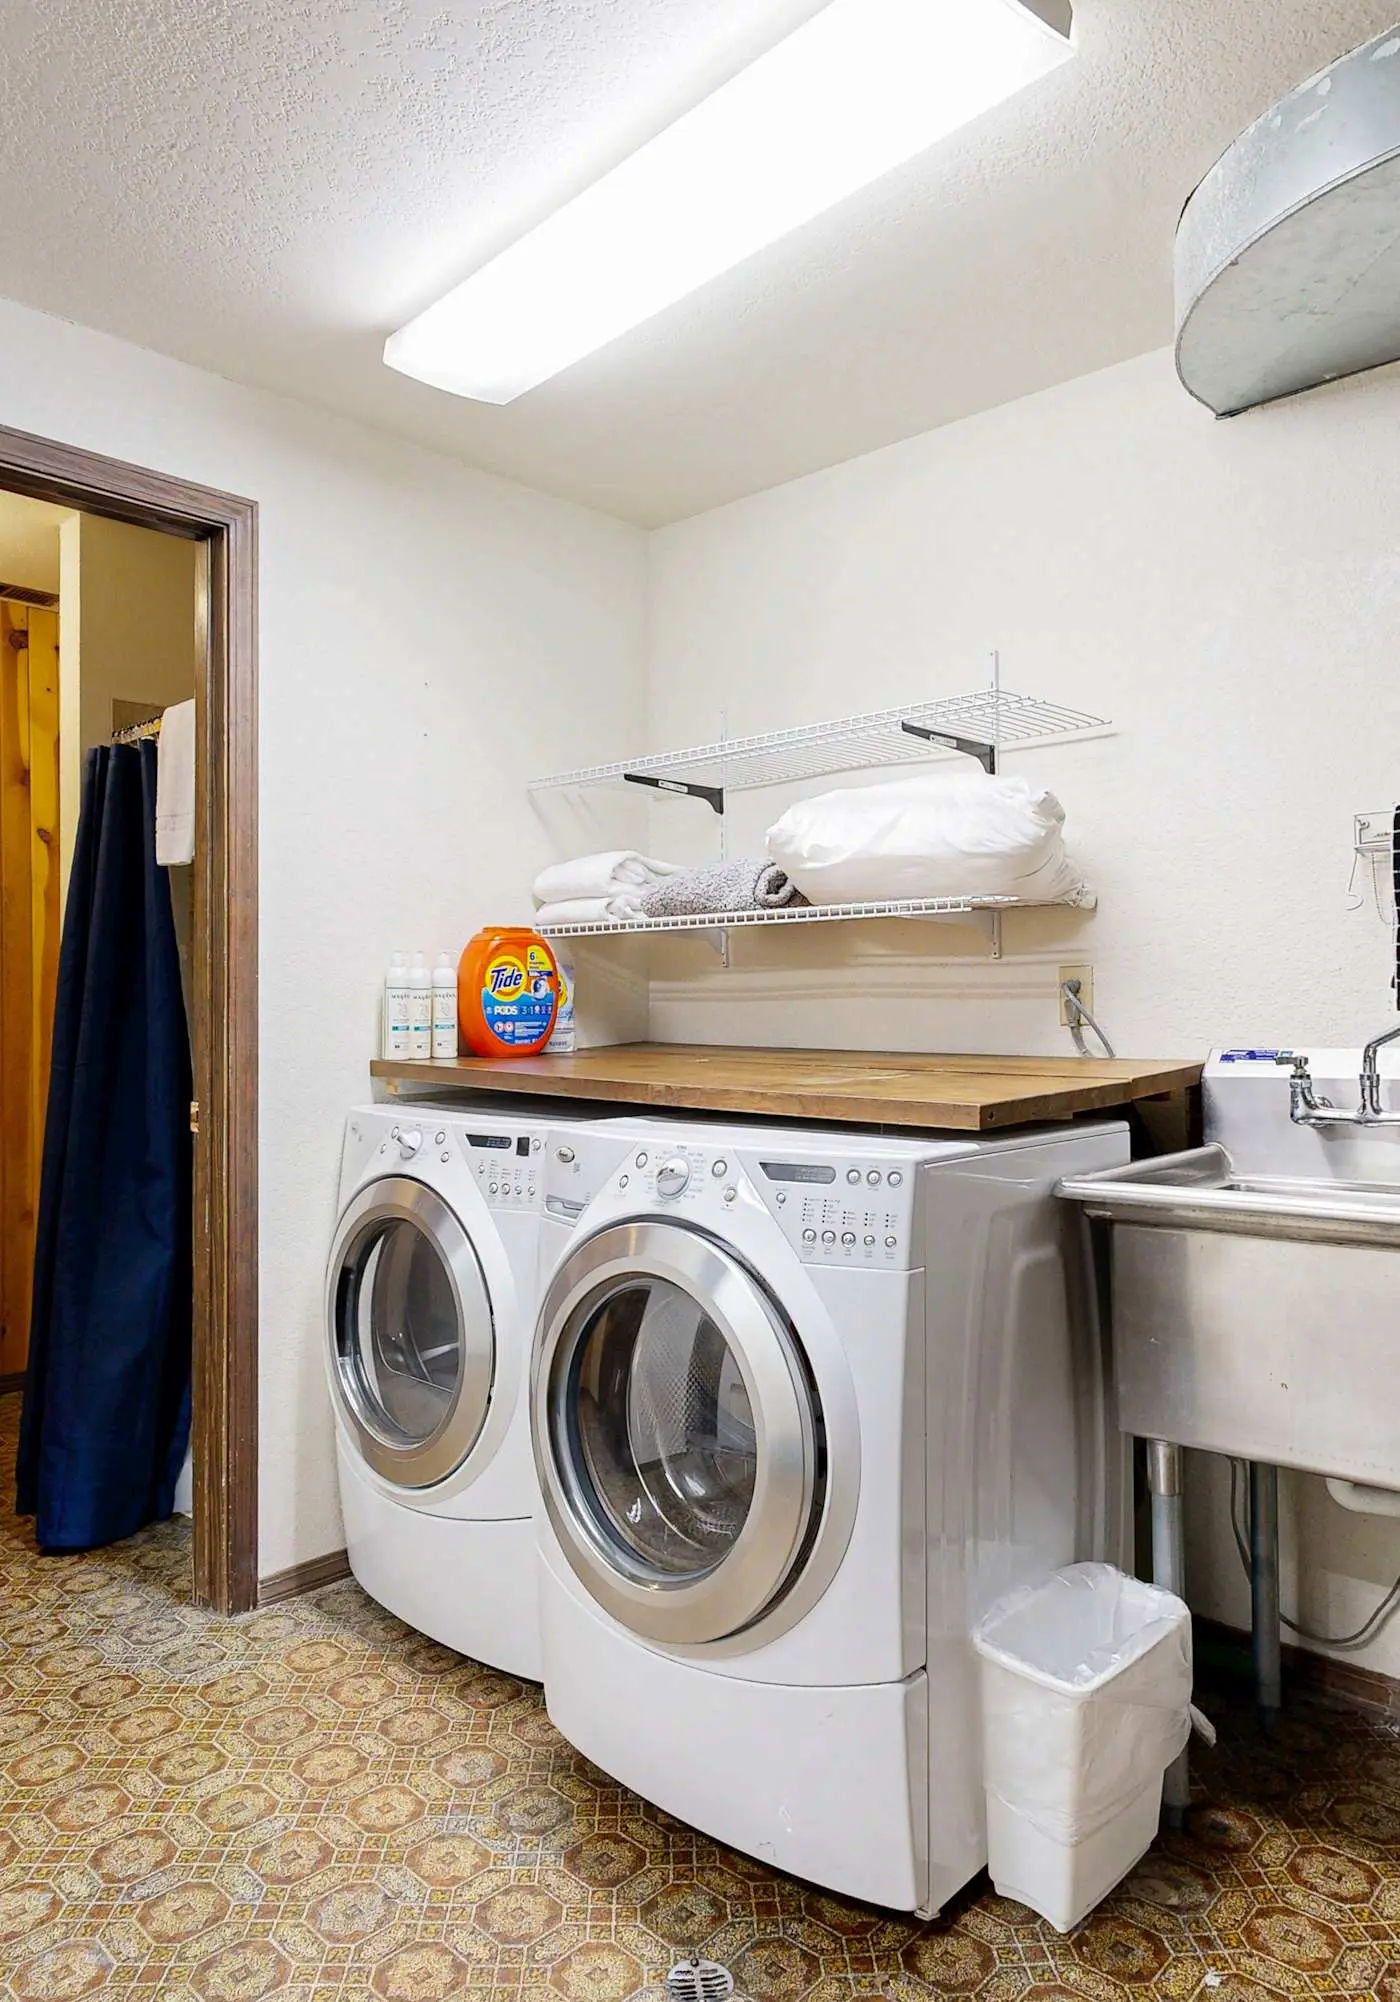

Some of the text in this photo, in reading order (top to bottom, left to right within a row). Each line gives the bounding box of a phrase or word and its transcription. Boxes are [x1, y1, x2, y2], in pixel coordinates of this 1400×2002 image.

[529, 951, 536, 961] 6
[491, 966, 523, 993] Tide
[494, 1005, 518, 1016] PODS
